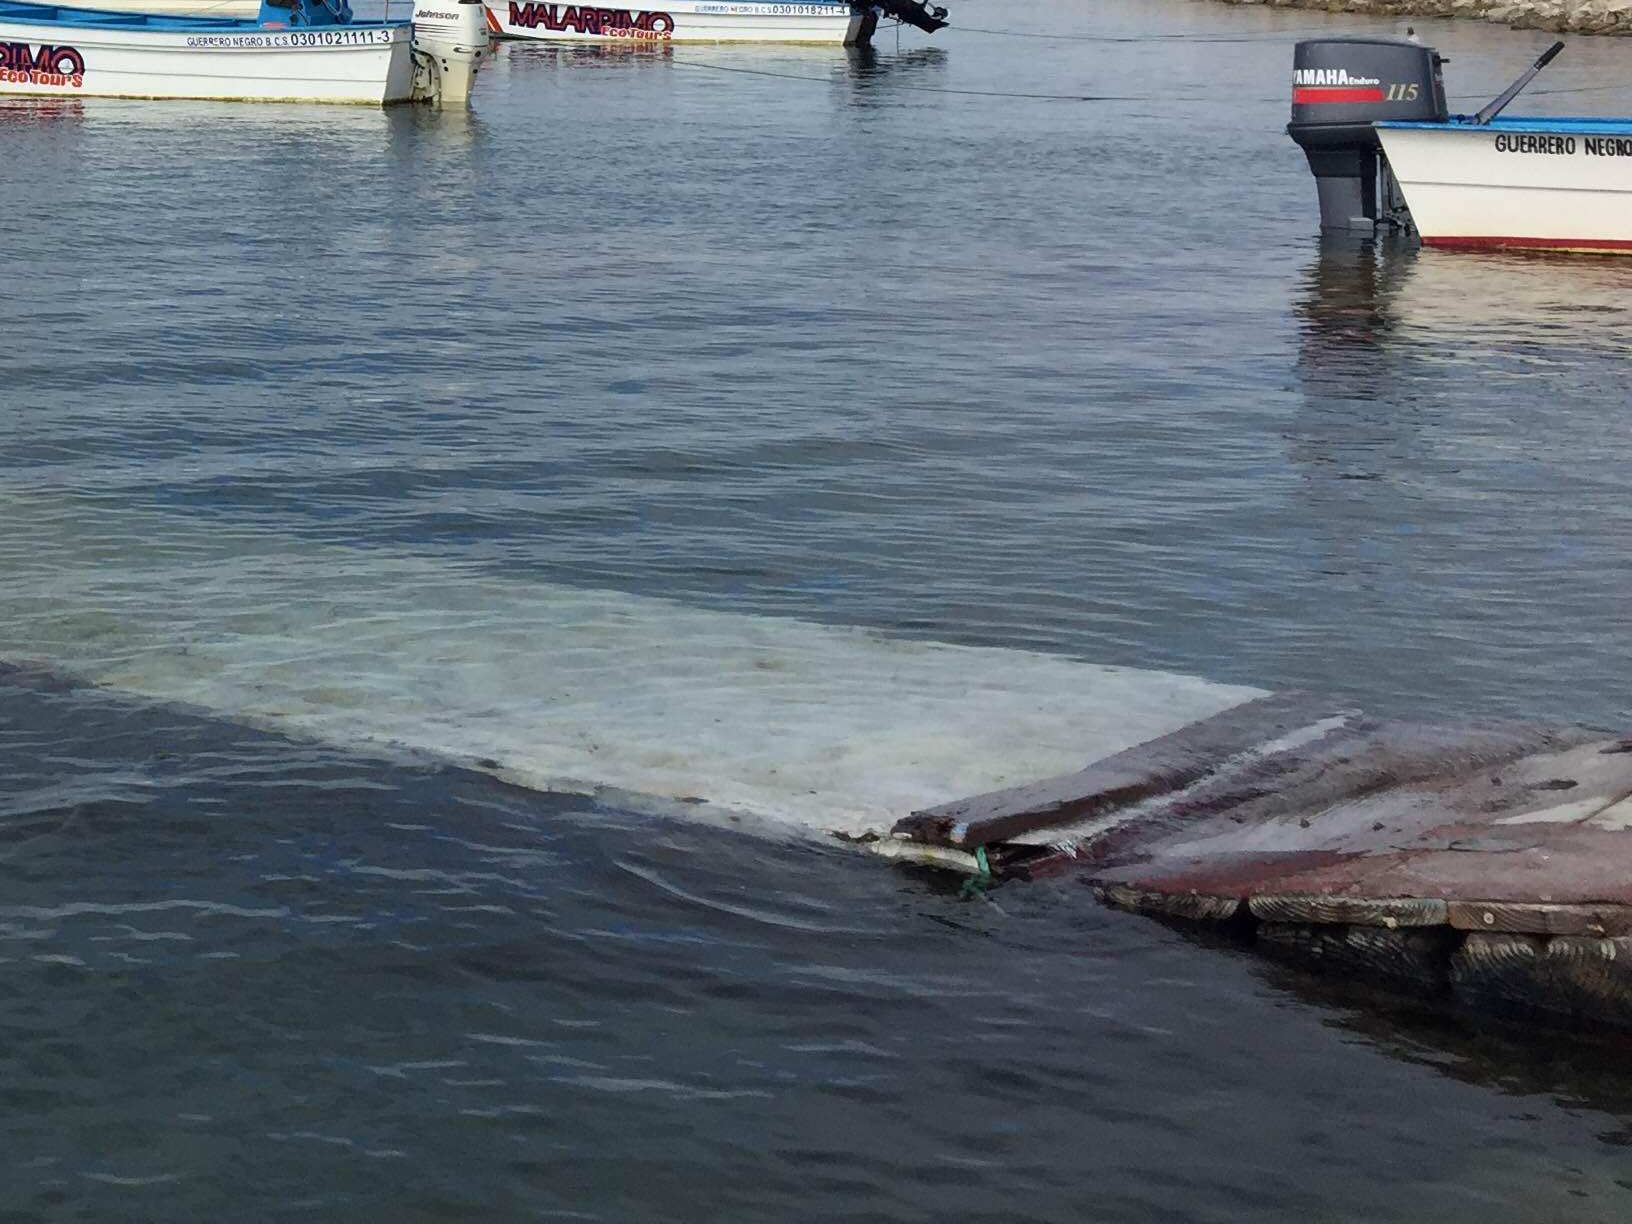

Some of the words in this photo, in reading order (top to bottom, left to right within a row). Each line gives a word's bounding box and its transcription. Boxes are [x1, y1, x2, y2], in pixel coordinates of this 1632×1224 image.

[415, 9, 460, 20] Johnson
[187, 36, 231, 47] GUERRERO
[233, 37, 264, 47] NEGRO
[290, 30, 390, 46] 0301021111-3
[31, 70, 83, 88] Tours
[1348, 76, 1380, 85] Enduro
[1386, 83, 1419, 101] 115
[1495, 135, 1576, 155] GUERRERO
[1584, 137, 1632, 157] NEGRO
